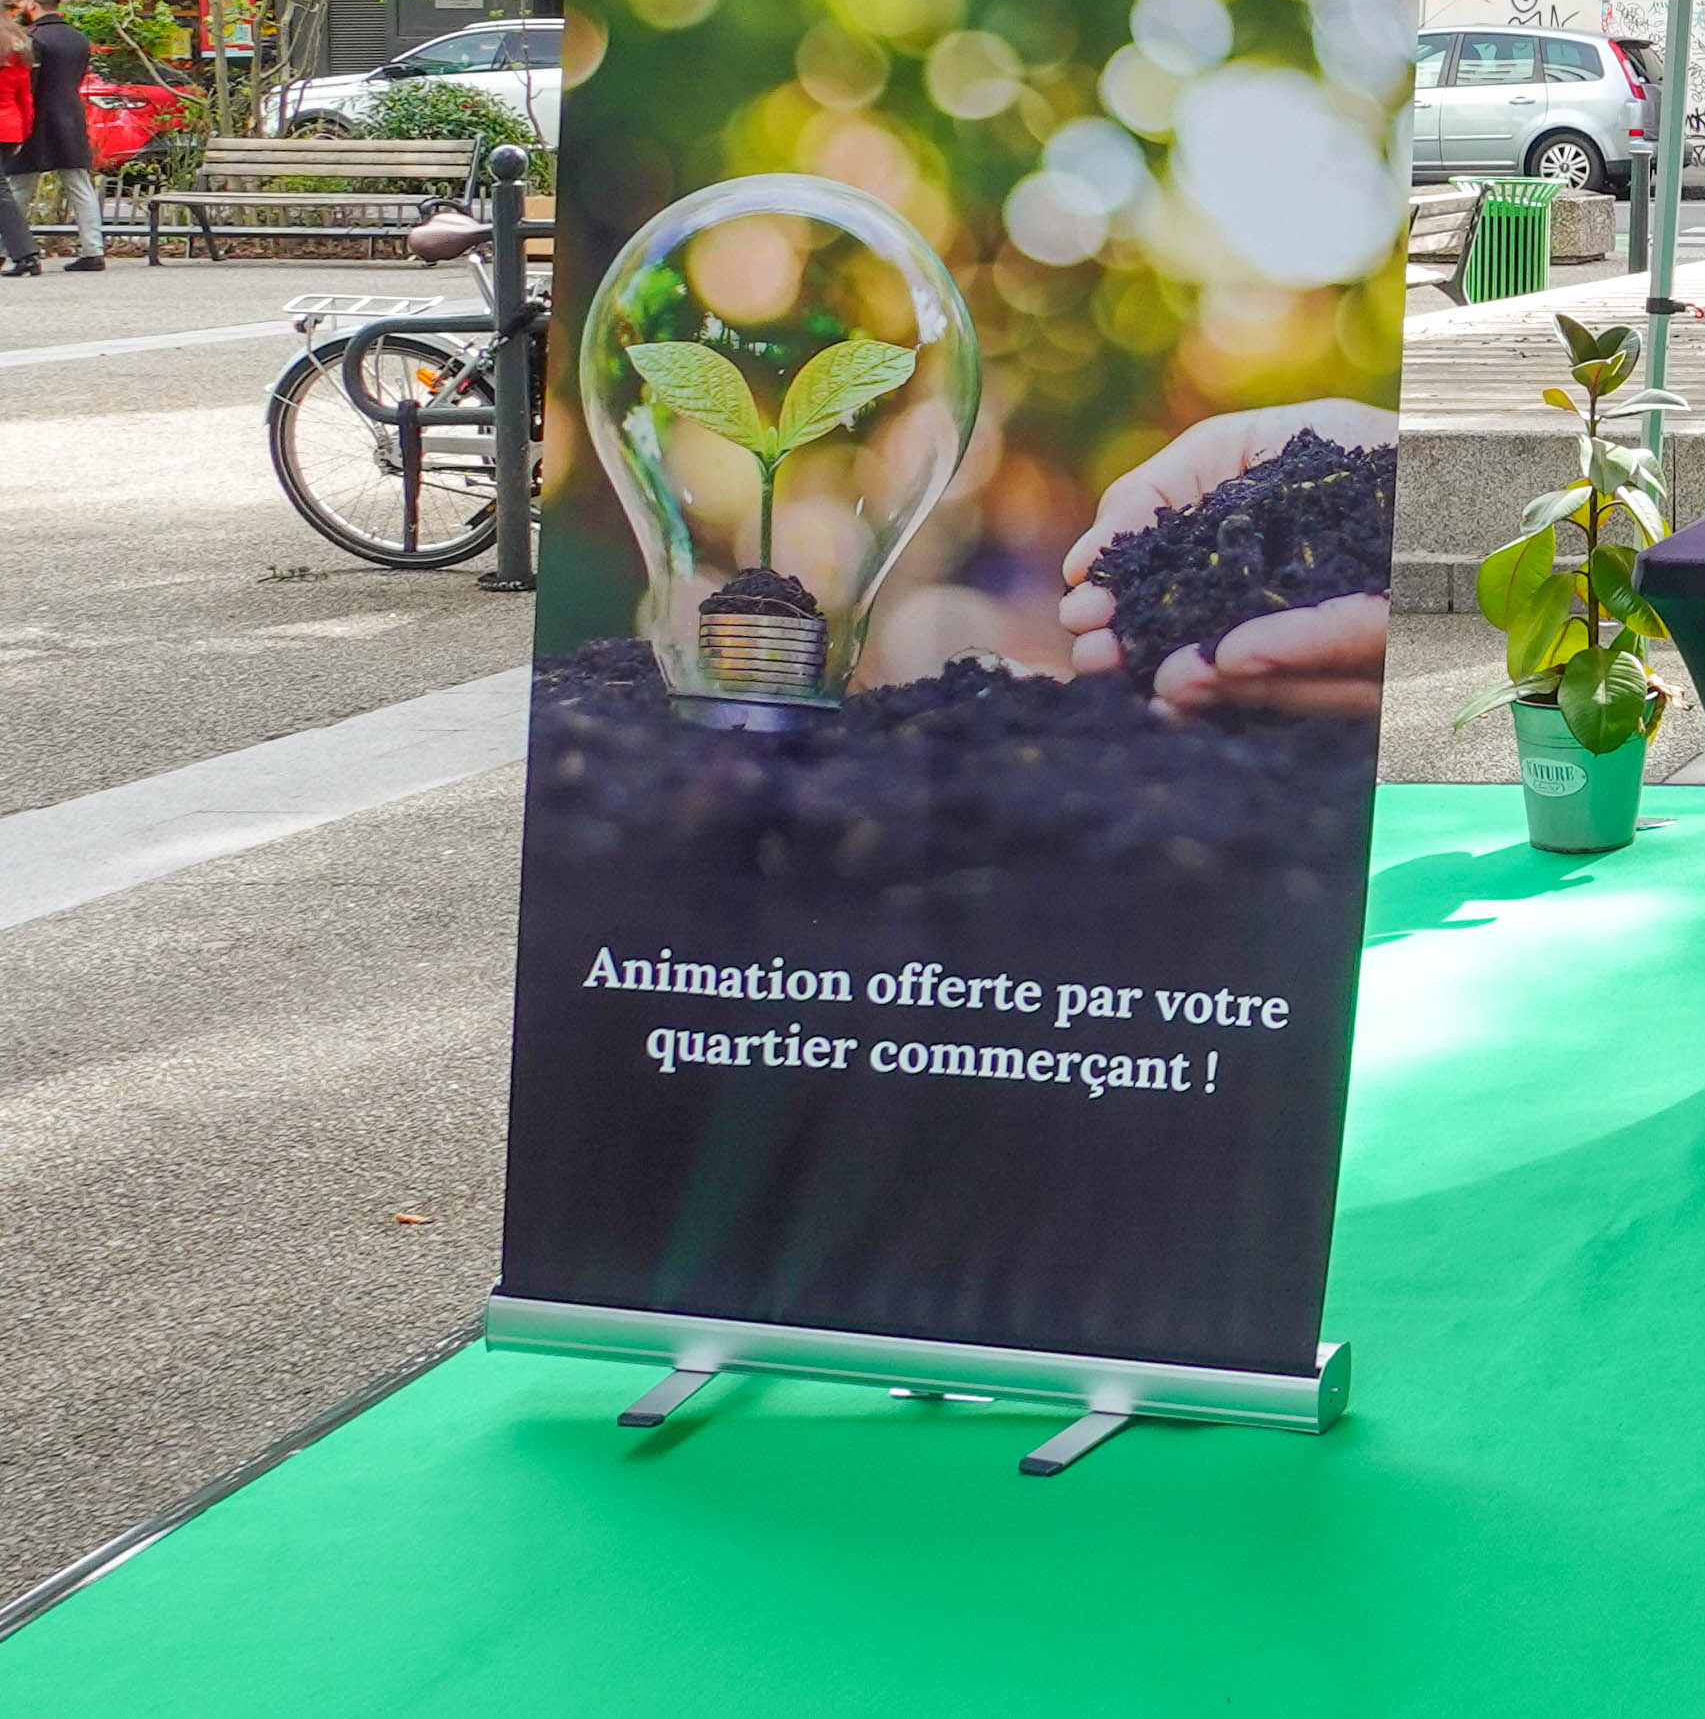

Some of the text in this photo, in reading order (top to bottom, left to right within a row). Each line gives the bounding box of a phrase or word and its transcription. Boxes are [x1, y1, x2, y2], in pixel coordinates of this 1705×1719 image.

[1527, 759, 1575, 782] NATURE
[582, 947, 1290, 1029] Animation offerte par votre
[645, 1023, 1220, 1099] quartier commerçant !
